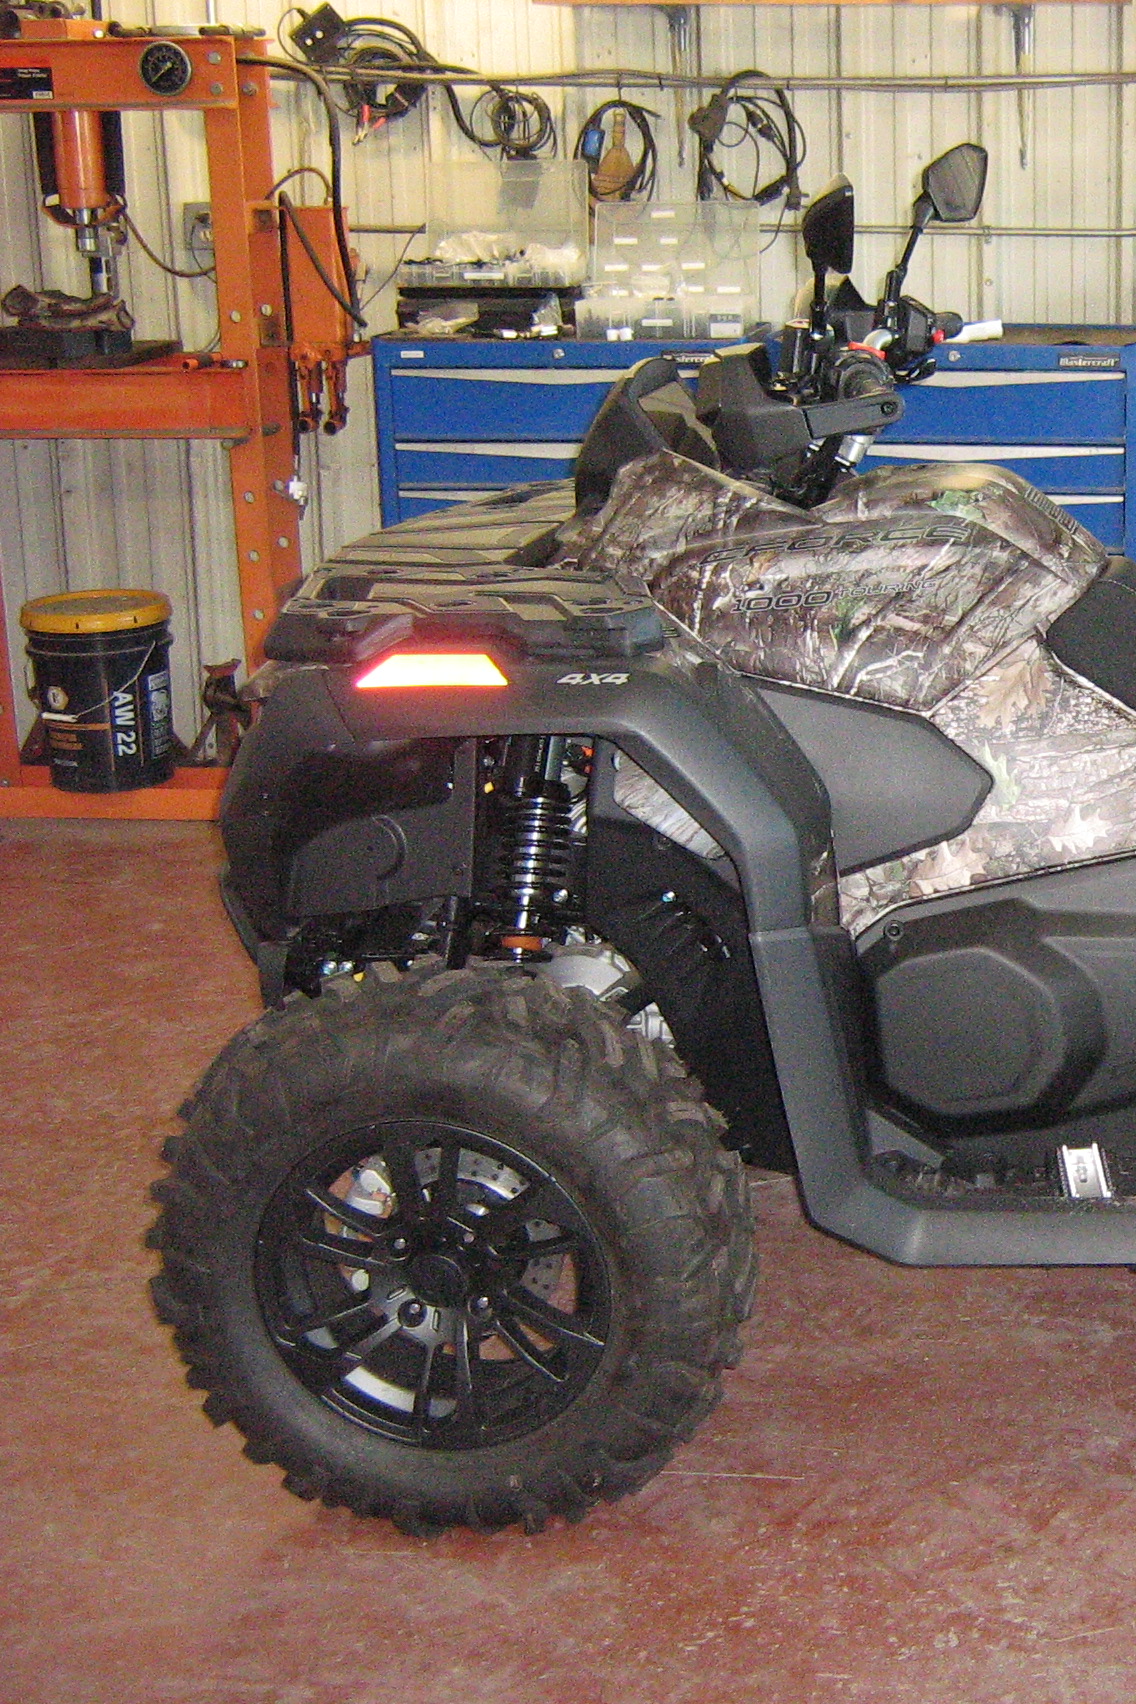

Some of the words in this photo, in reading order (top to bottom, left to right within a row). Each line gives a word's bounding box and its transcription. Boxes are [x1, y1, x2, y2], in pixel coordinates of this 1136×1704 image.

[699, 525, 973, 566] CFORCE
[730, 591, 835, 614] 1000
[834, 579, 938, 598] TOURING
[111, 691, 136, 726] AW
[114, 730, 137, 757] 22
